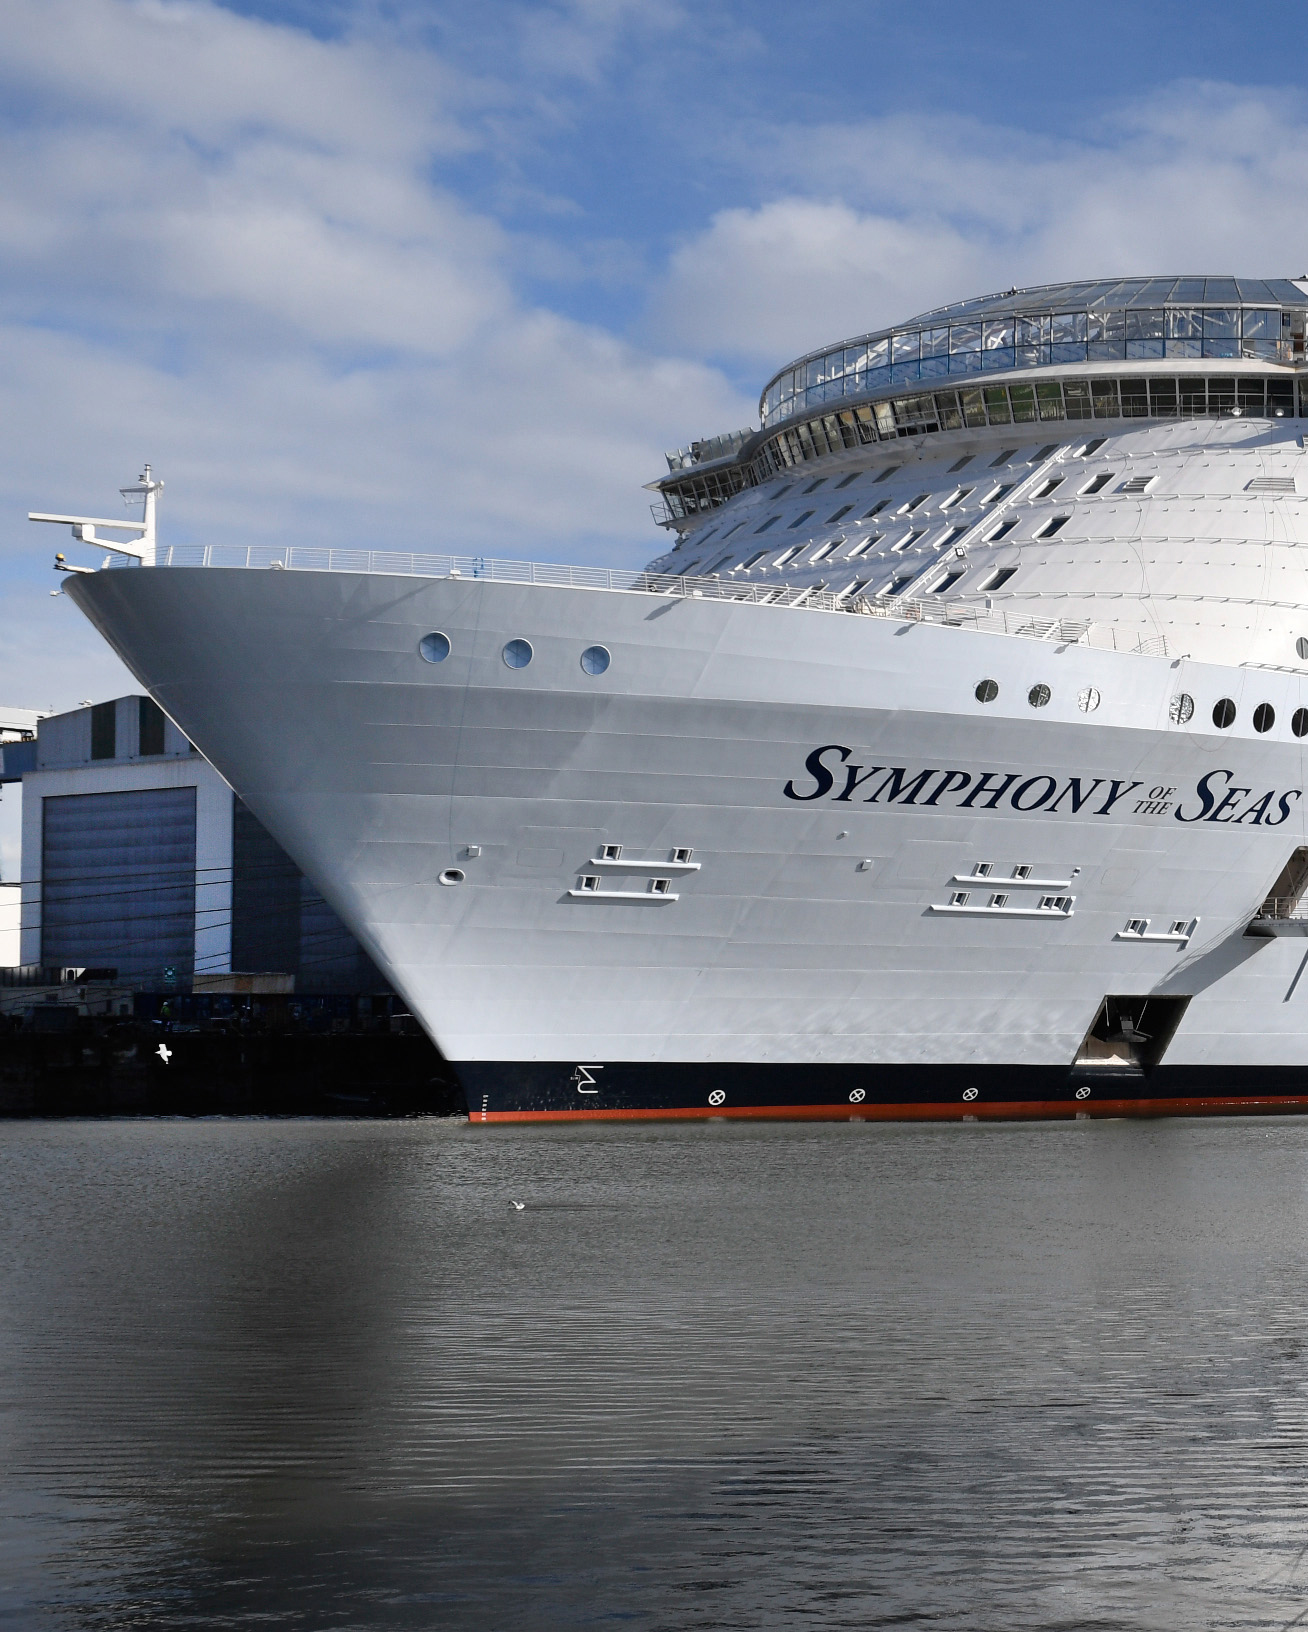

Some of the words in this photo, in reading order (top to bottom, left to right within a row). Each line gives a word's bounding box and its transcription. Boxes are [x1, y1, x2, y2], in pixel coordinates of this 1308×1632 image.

[783, 745, 1144, 815] SYMPHONY
[1148, 786, 1177, 800] OF
[1174, 769, 1303, 825] SEAS
[1132, 800, 1173, 815] THE
